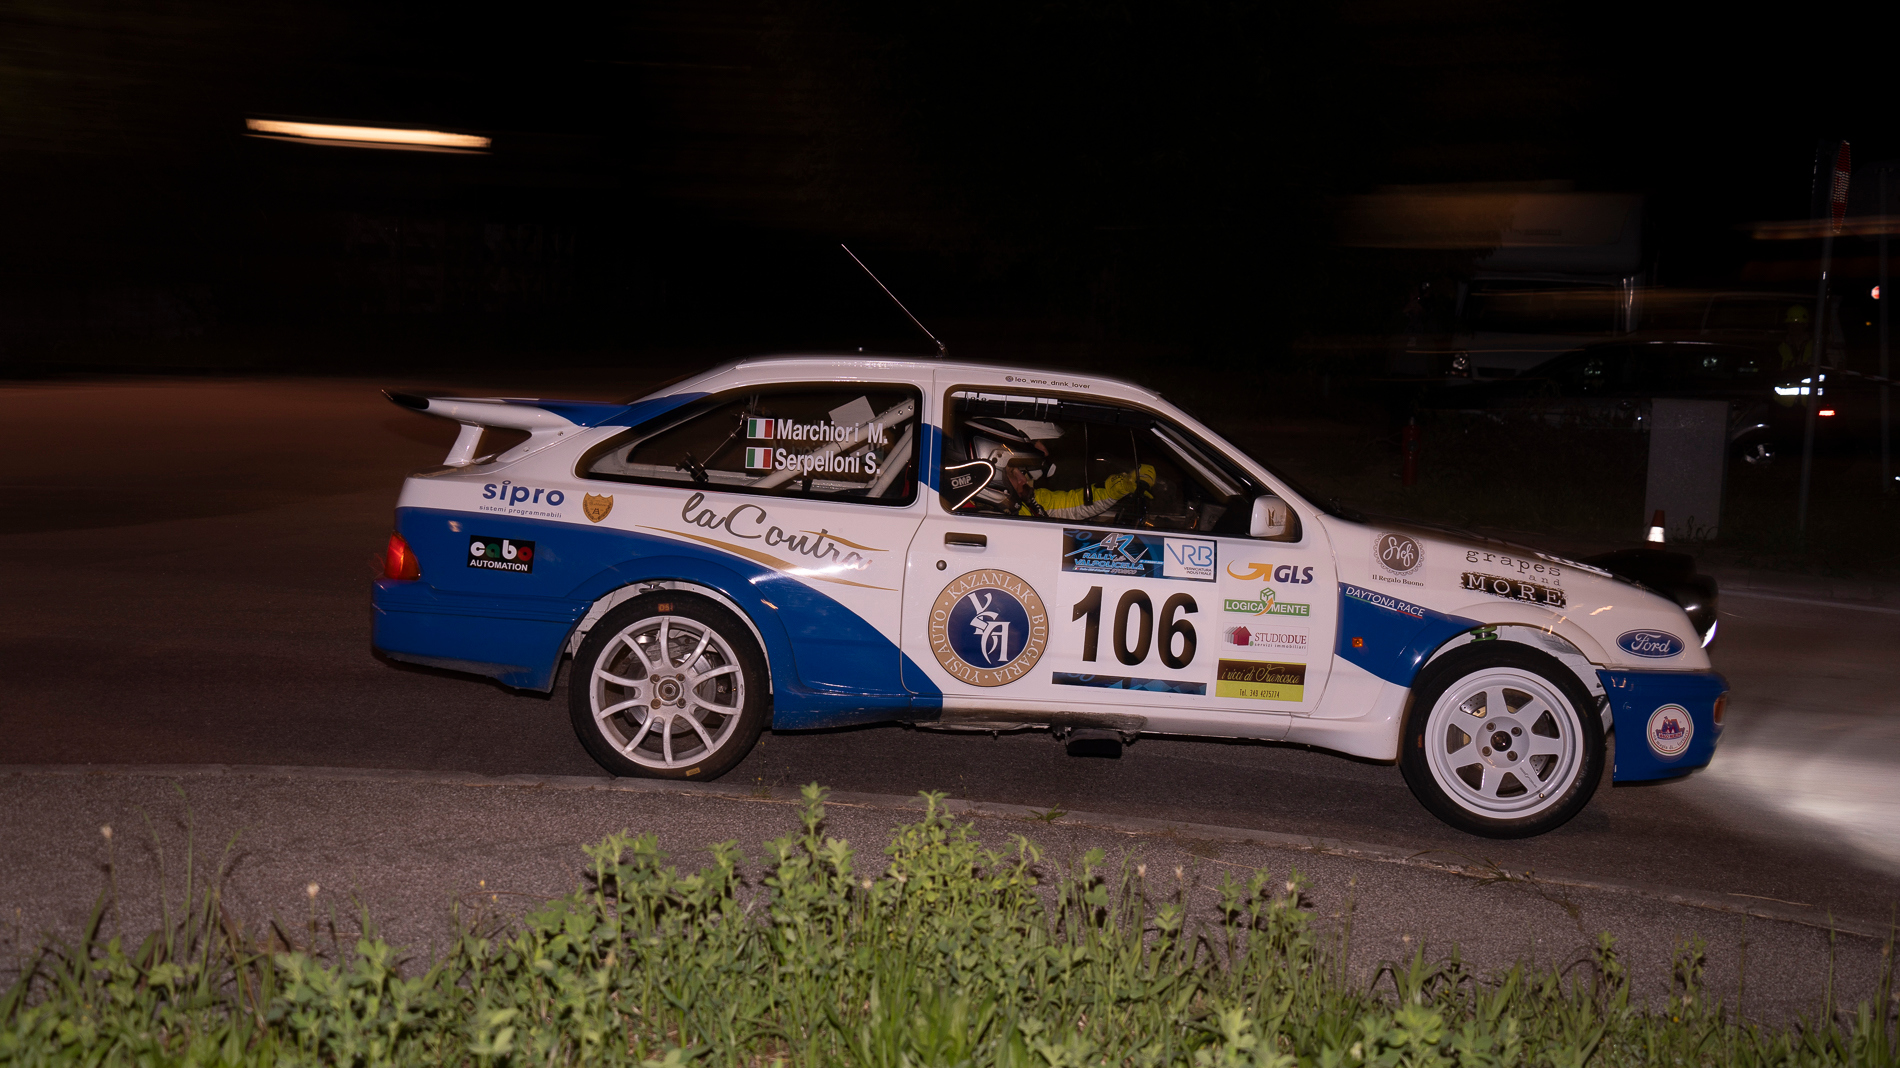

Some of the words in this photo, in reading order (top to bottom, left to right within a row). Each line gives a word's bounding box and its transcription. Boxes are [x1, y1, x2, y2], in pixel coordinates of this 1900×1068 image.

[777, 418, 859, 442] Marchiori
[868, 422, 888, 444] M.
[775, 447, 860, 476] Serpelloni
[864, 451, 881, 475] S.
[482, 480, 565, 506] sipro
[951, 475, 972, 488] OMP
[479, 505, 507, 513] sistemi
[508, 509, 562, 519] programmabili
[470, 539, 533, 562] cabo
[1081, 552, 1117, 560] RALLY
[1166, 543, 1213, 567] VRB
[470, 559, 528, 572] AUTOMATION
[1074, 559, 1145, 571] VALPOLICELLA
[1274, 565, 1314, 584] GLS
[1465, 550, 1561, 577] grapes
[946, 572, 1035, 604] KAZANLAK
[1379, 575, 1402, 583] Regalo
[1402, 578, 1424, 587] Buono
[1466, 574, 1562, 606] MORE
[1528, 574, 1561, 586] and
[1345, 586, 1395, 608] DAYTONA
[1396, 602, 1426, 617] RACE
[932, 609, 950, 653] AUTO
[1072, 586, 1199, 670] 106
[1254, 632, 1307, 644] STUDIODUE
[993, 613, 1046, 683] BULGARIA
[1631, 632, 1671, 653] Ford
[944, 656, 980, 683] YUSI
